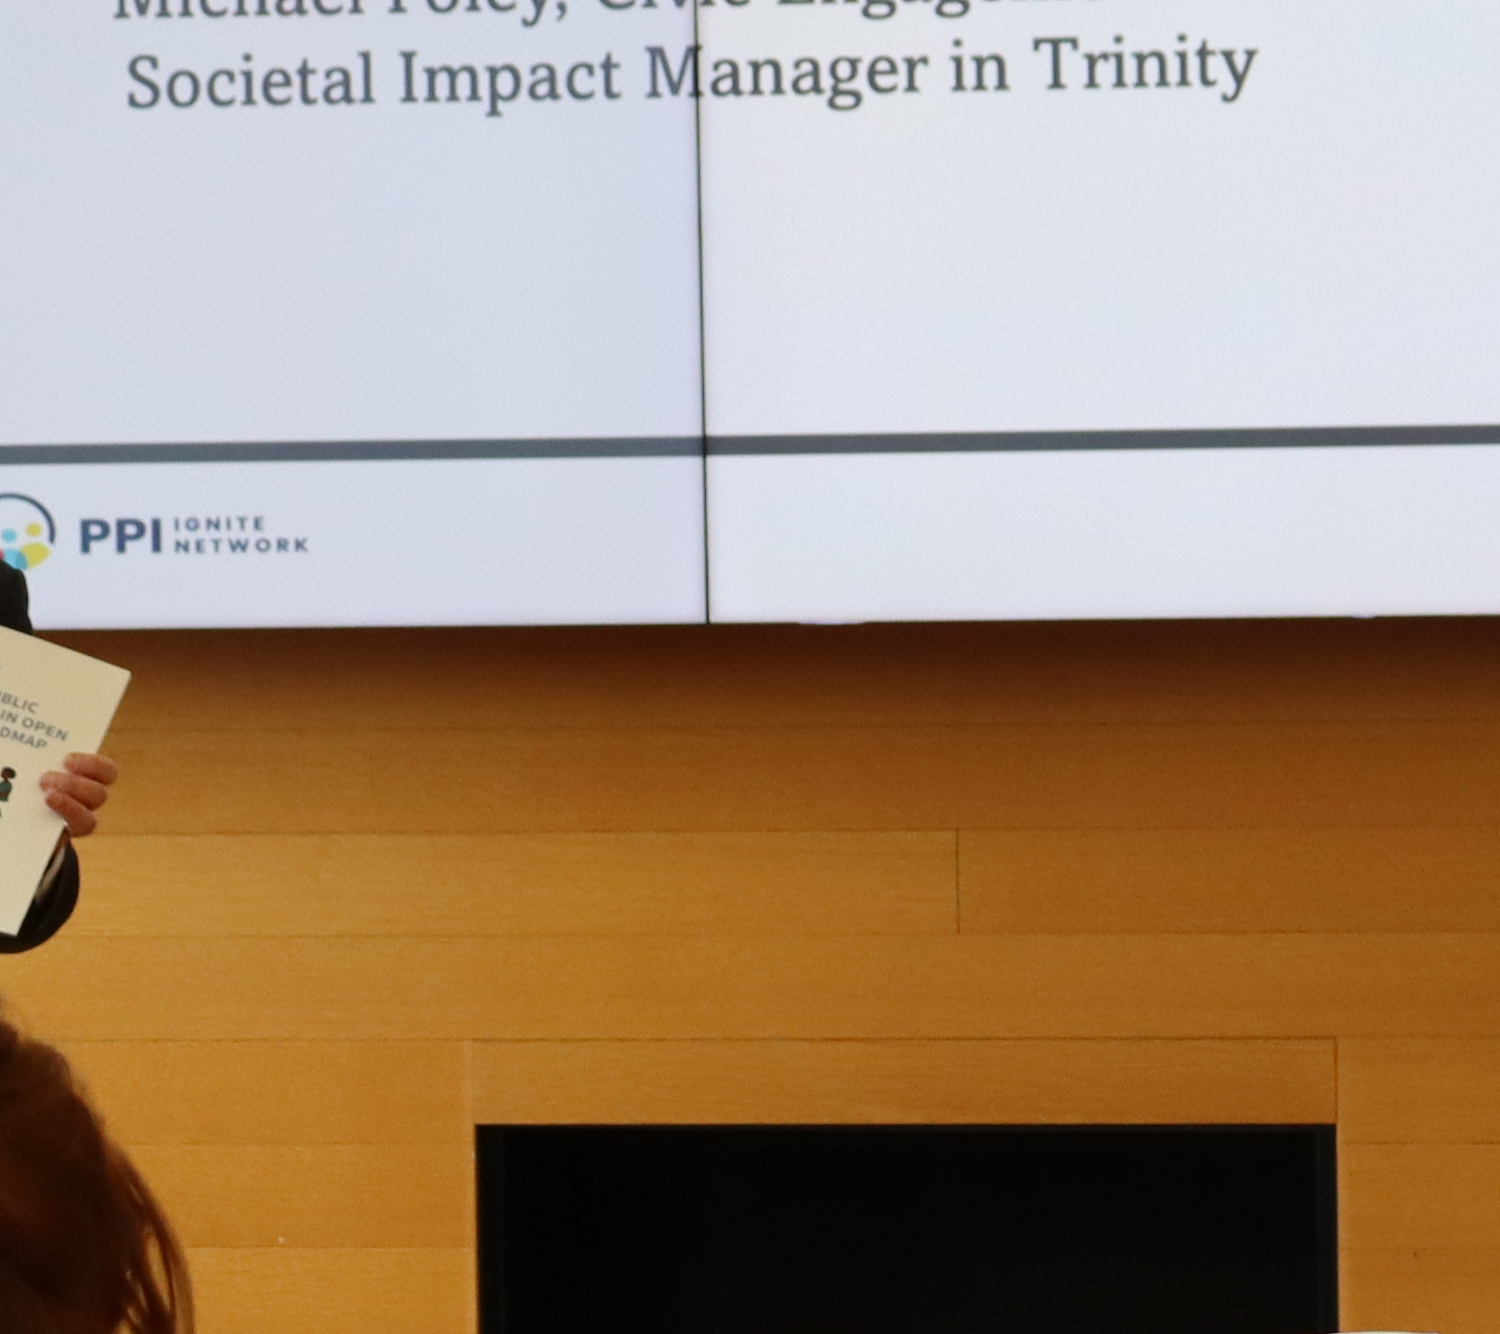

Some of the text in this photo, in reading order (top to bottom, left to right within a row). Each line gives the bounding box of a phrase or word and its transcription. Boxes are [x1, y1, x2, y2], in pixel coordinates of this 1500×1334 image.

[126, 35, 1259, 119] Societal Impact Manager in Trinity
[79, 517, 162, 555] PPI
[173, 515, 266, 533] IGNITE
[174, 537, 310, 555] NETWORK
[0, 709, 18, 724] IN
[21, 717, 69, 742] OPEN
